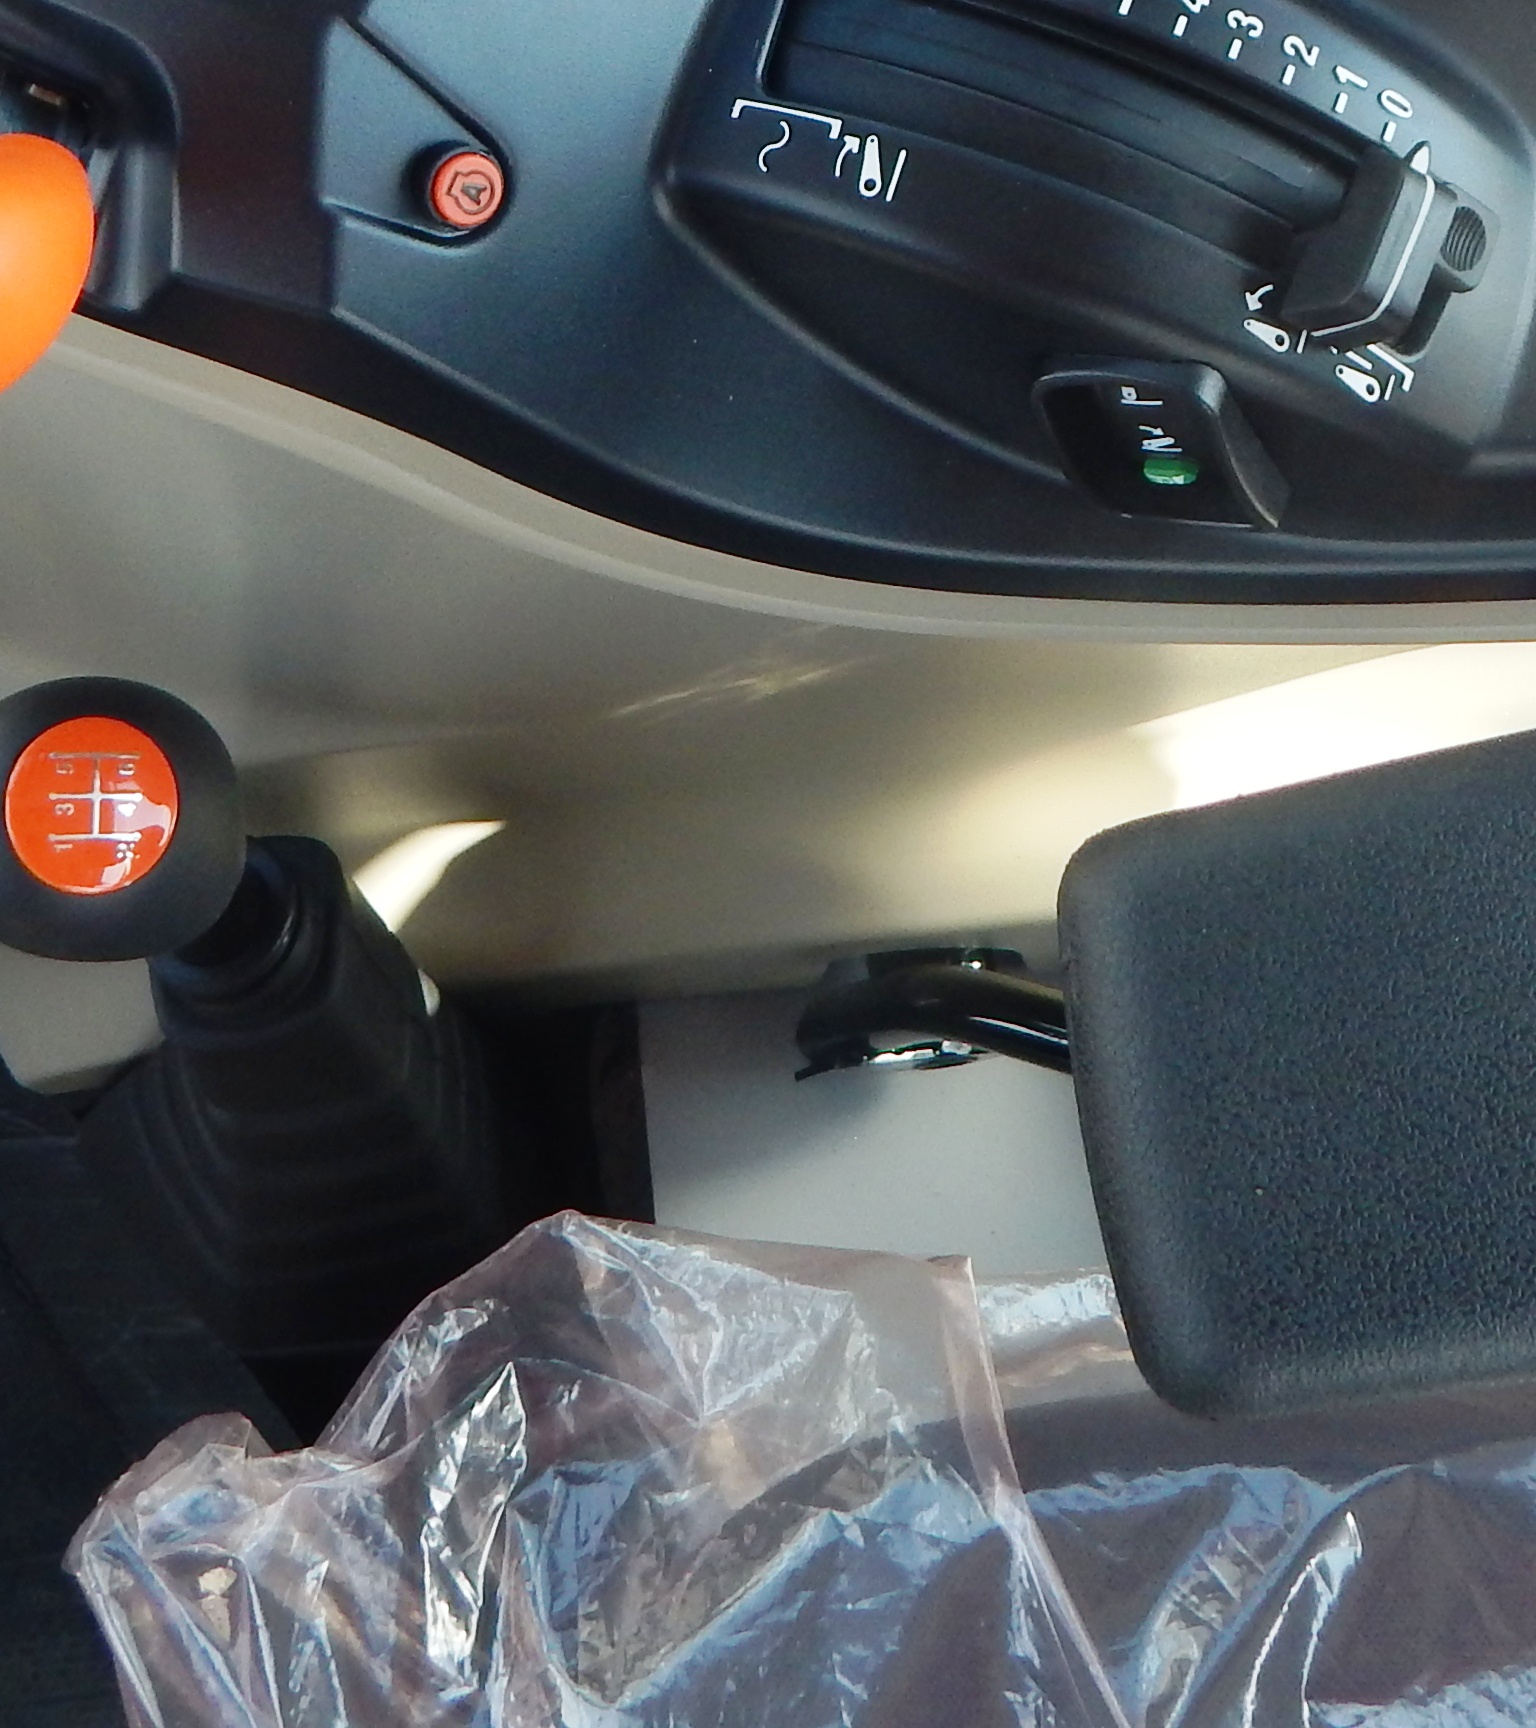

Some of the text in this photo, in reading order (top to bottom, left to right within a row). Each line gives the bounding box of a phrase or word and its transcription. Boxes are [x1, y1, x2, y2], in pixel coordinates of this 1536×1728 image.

[1227, 9, 1264, 39] 3
[1282, 34, 1320, 68] 2
[1334, 65, 1369, 89] 1
[1380, 89, 1413, 120] 0
[54, 803, 74, 816] 3
